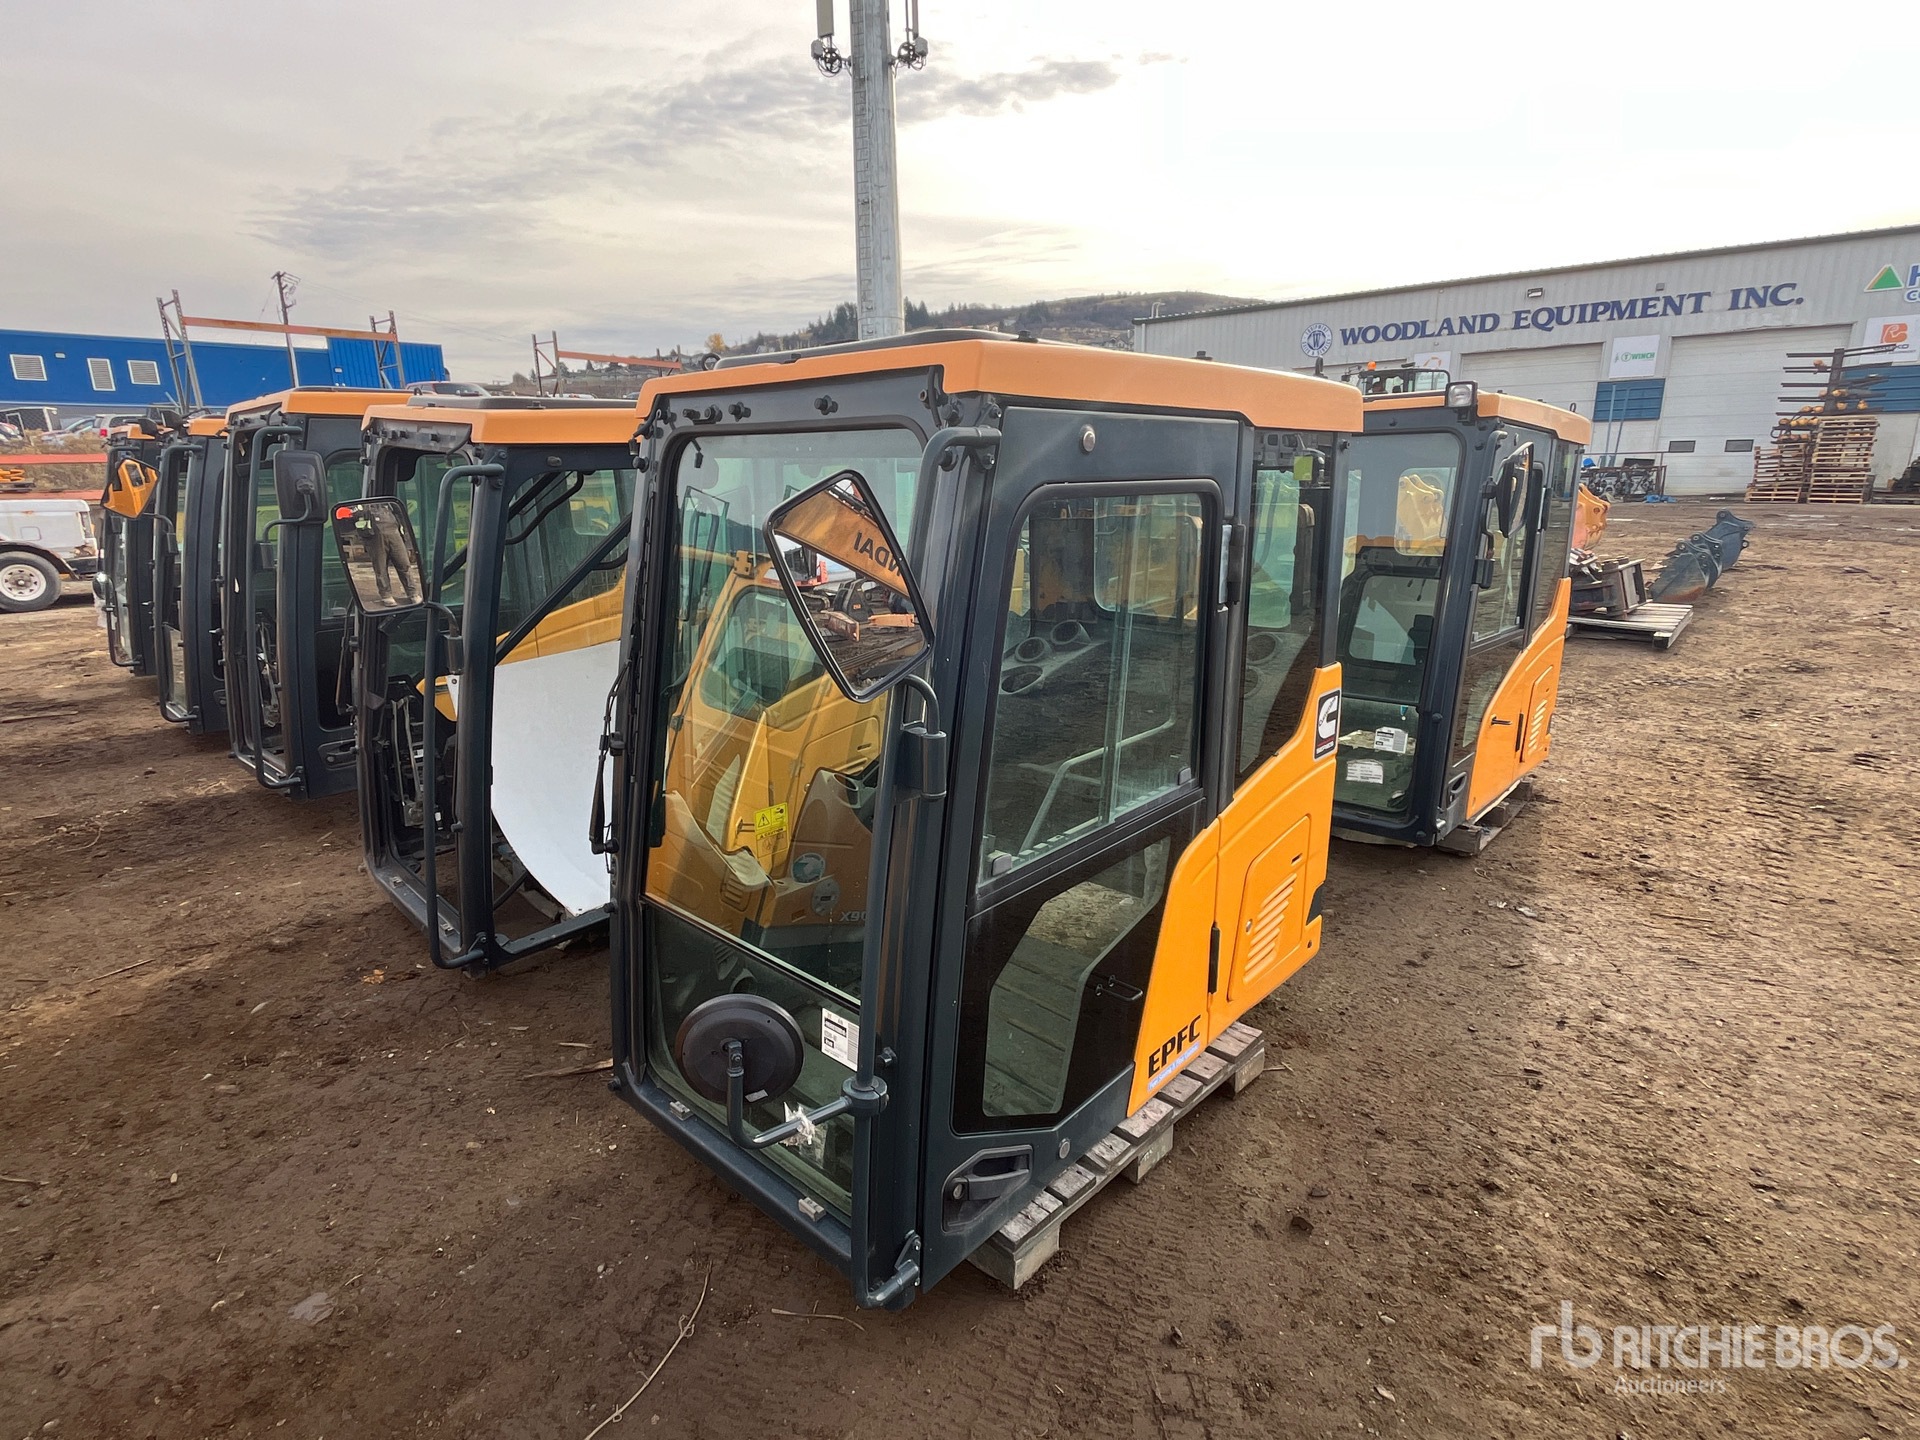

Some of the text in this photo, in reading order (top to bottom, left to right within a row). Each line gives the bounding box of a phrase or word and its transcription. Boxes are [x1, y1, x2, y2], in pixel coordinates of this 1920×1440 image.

[1340, 282, 1804, 346] WOODLAND EQUIPMENT INC.
[1148, 1014, 1201, 1079] EPFC
